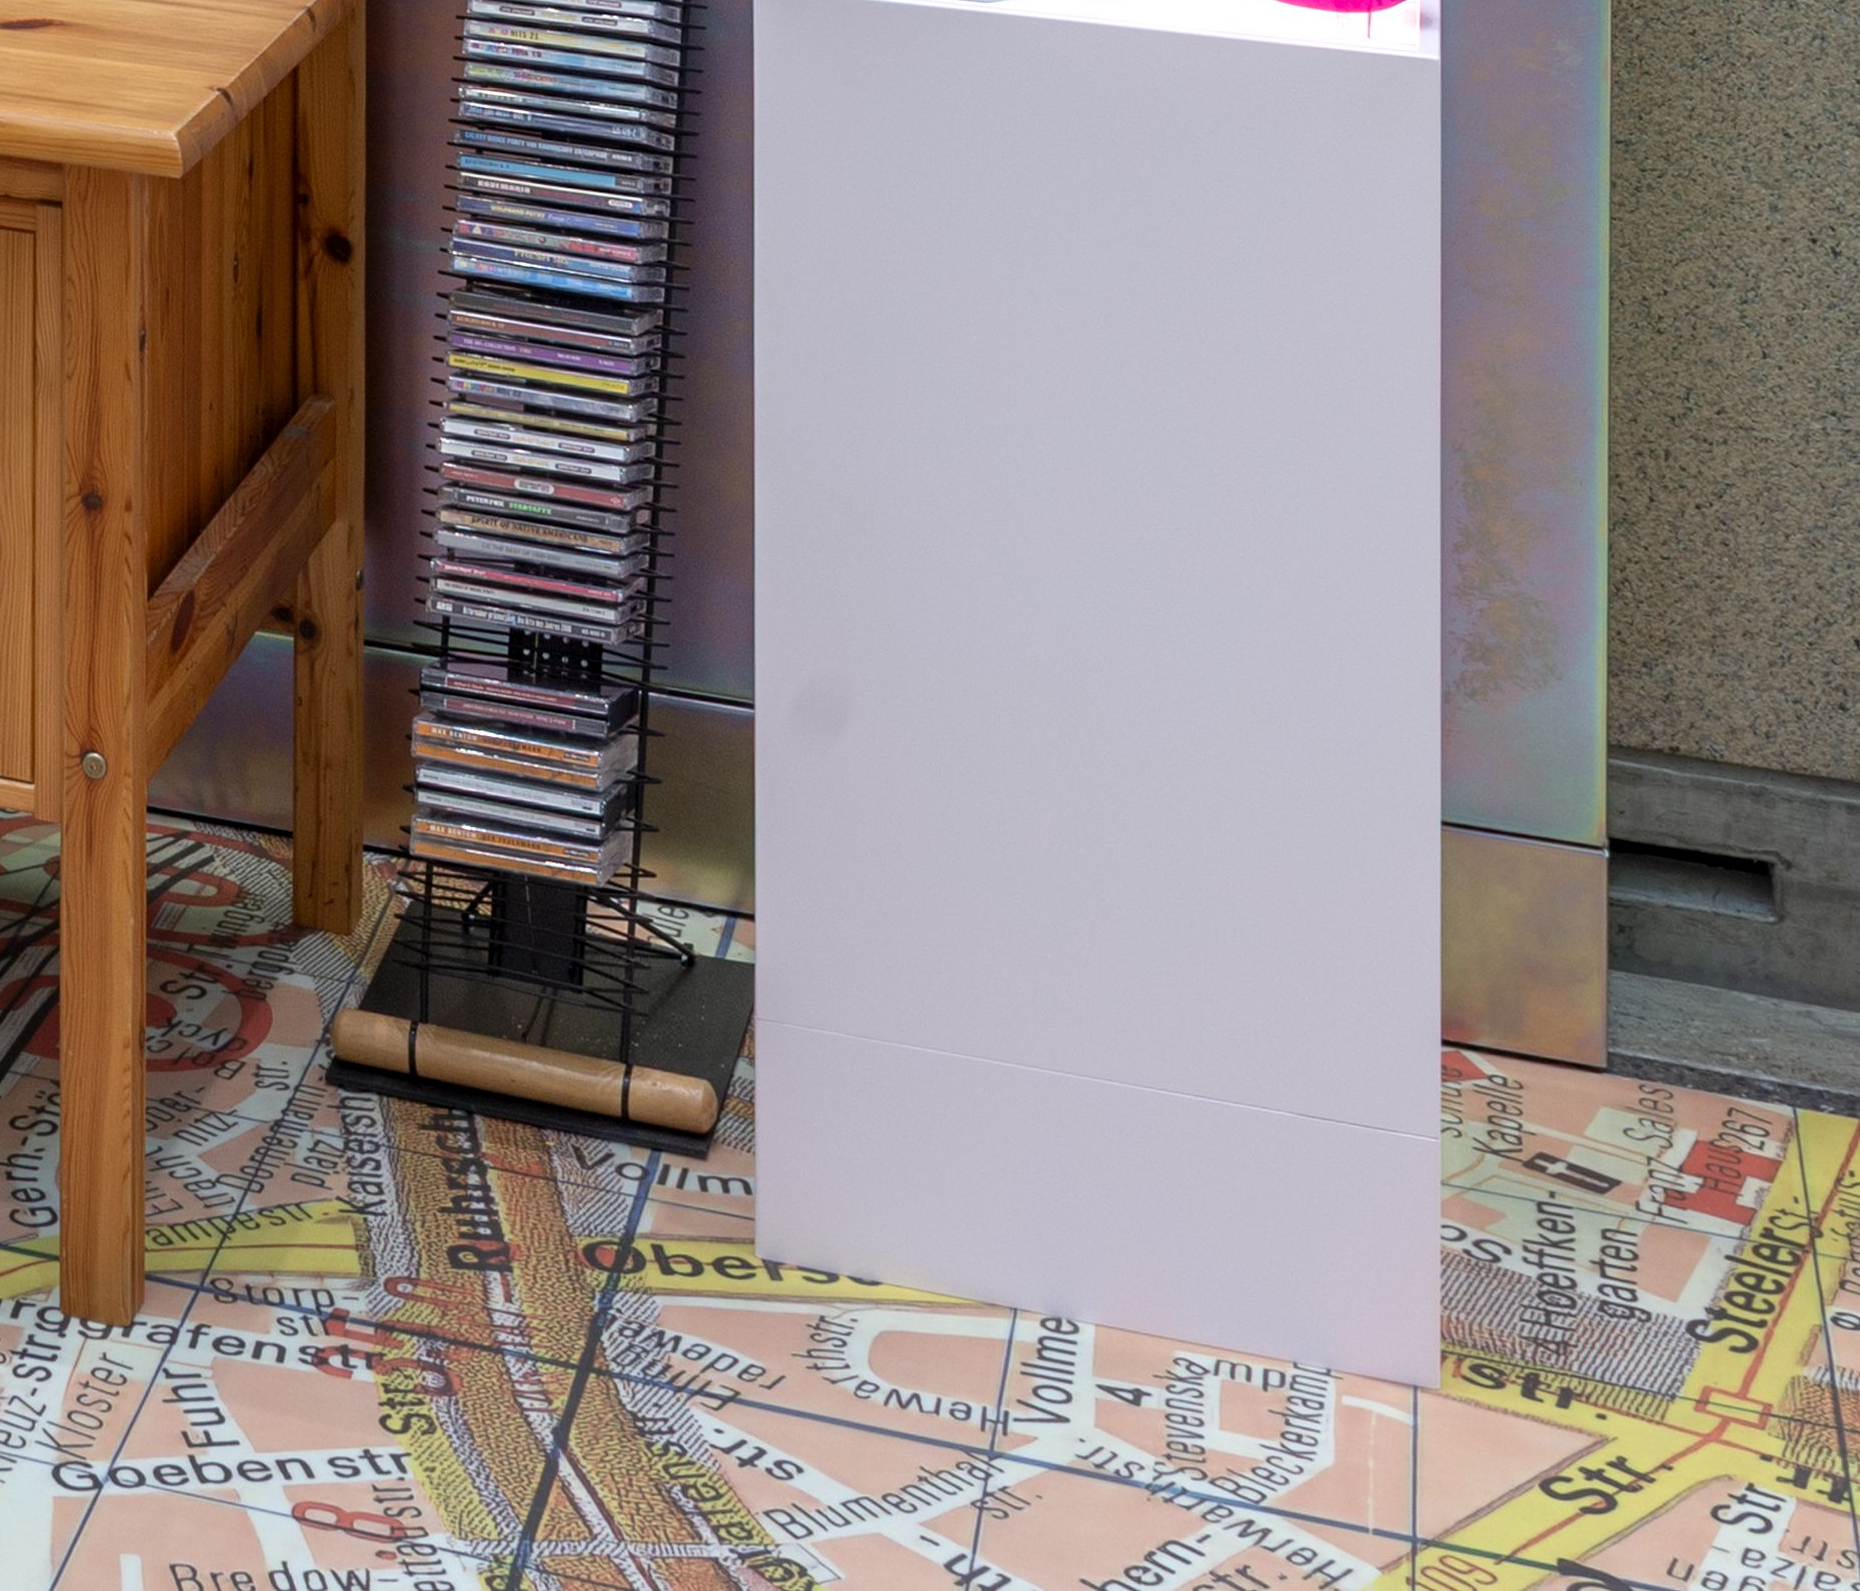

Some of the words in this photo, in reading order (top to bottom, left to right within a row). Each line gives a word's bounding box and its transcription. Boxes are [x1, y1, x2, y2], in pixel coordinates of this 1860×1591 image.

[1473, 1073, 1538, 1162] Kapelle
[1624, 1083, 1679, 1153] Sales
[1719, 1106, 1775, 1152] 267
[1635, 1155, 1688, 1226] Franz
[34, 1349, 138, 1461] Kloster
[161, 1365, 241, 1450] Fuhr
